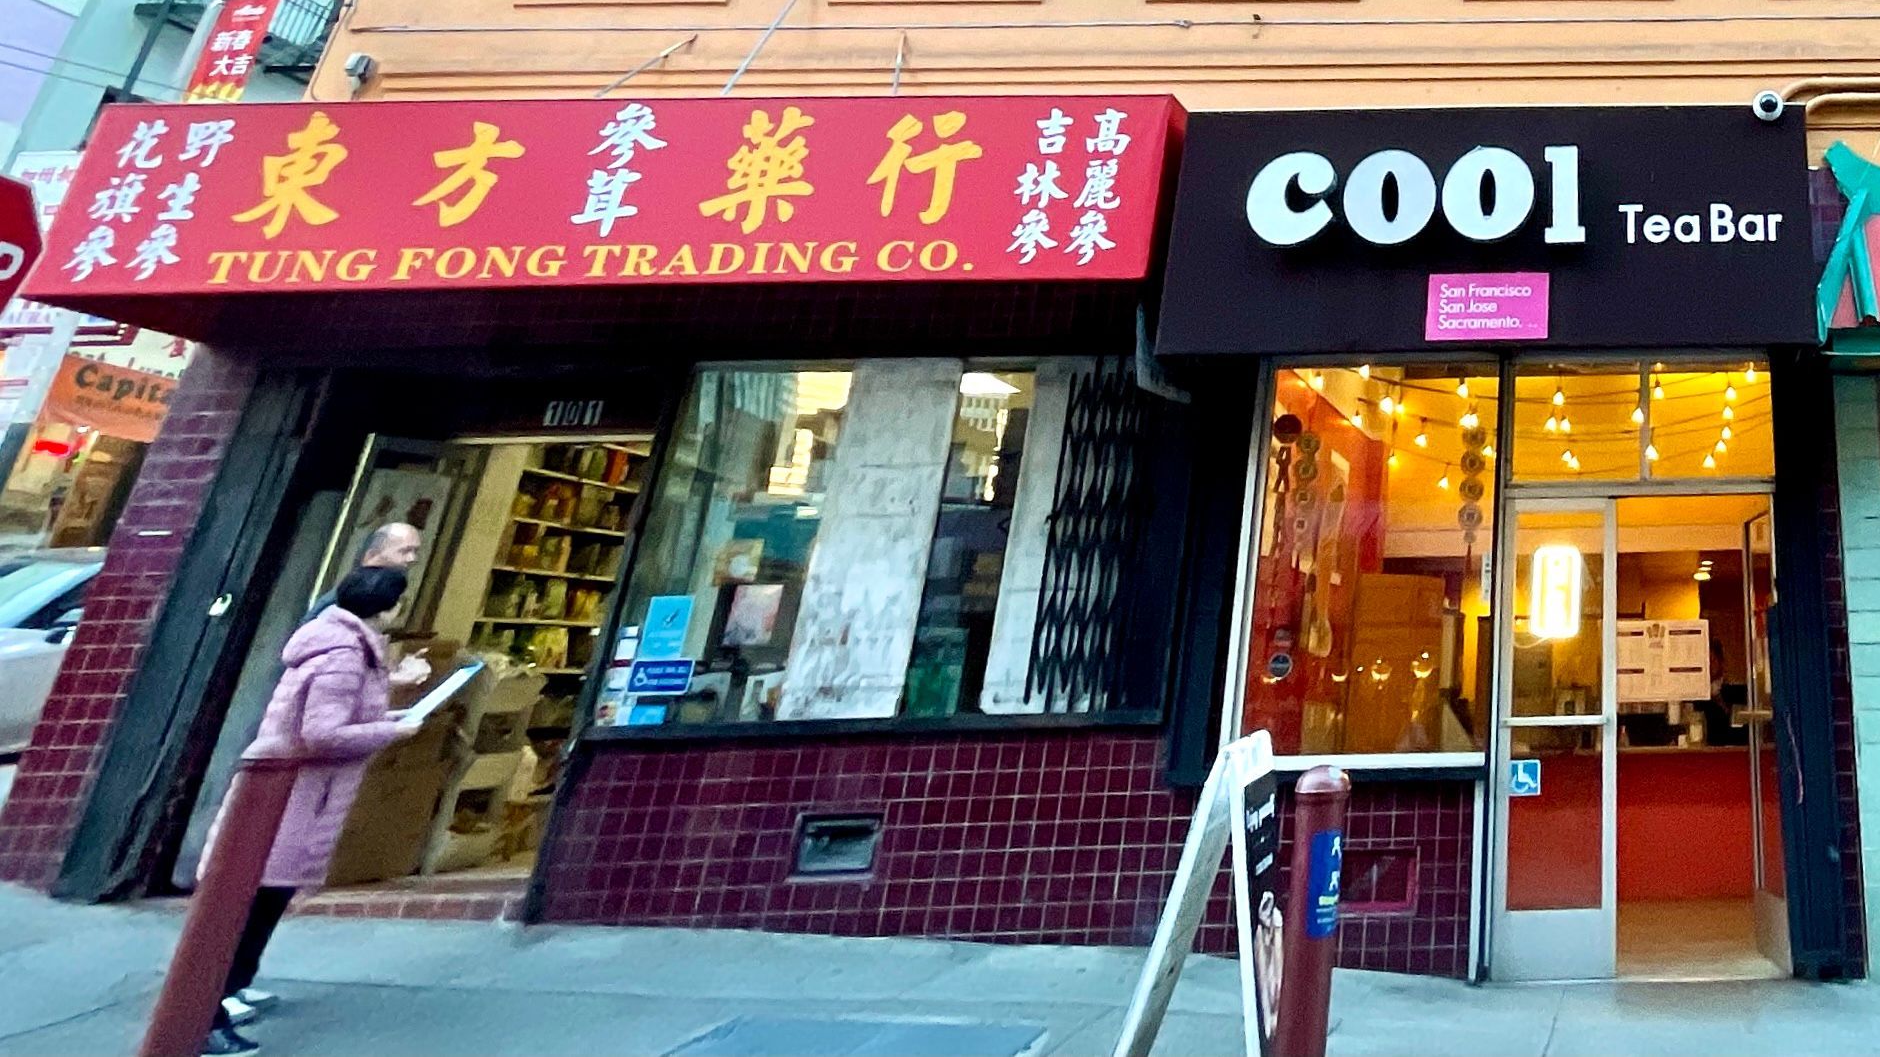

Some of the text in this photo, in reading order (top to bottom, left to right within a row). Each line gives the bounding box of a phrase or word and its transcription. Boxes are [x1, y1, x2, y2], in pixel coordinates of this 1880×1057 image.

[1619, 202, 1783, 243] Tea Bar
[207, 239, 974, 285] TUNG FONG TRADING CO.
[1440, 283, 1532, 298] San Francisco
[1438, 299, 1498, 314] San Jose
